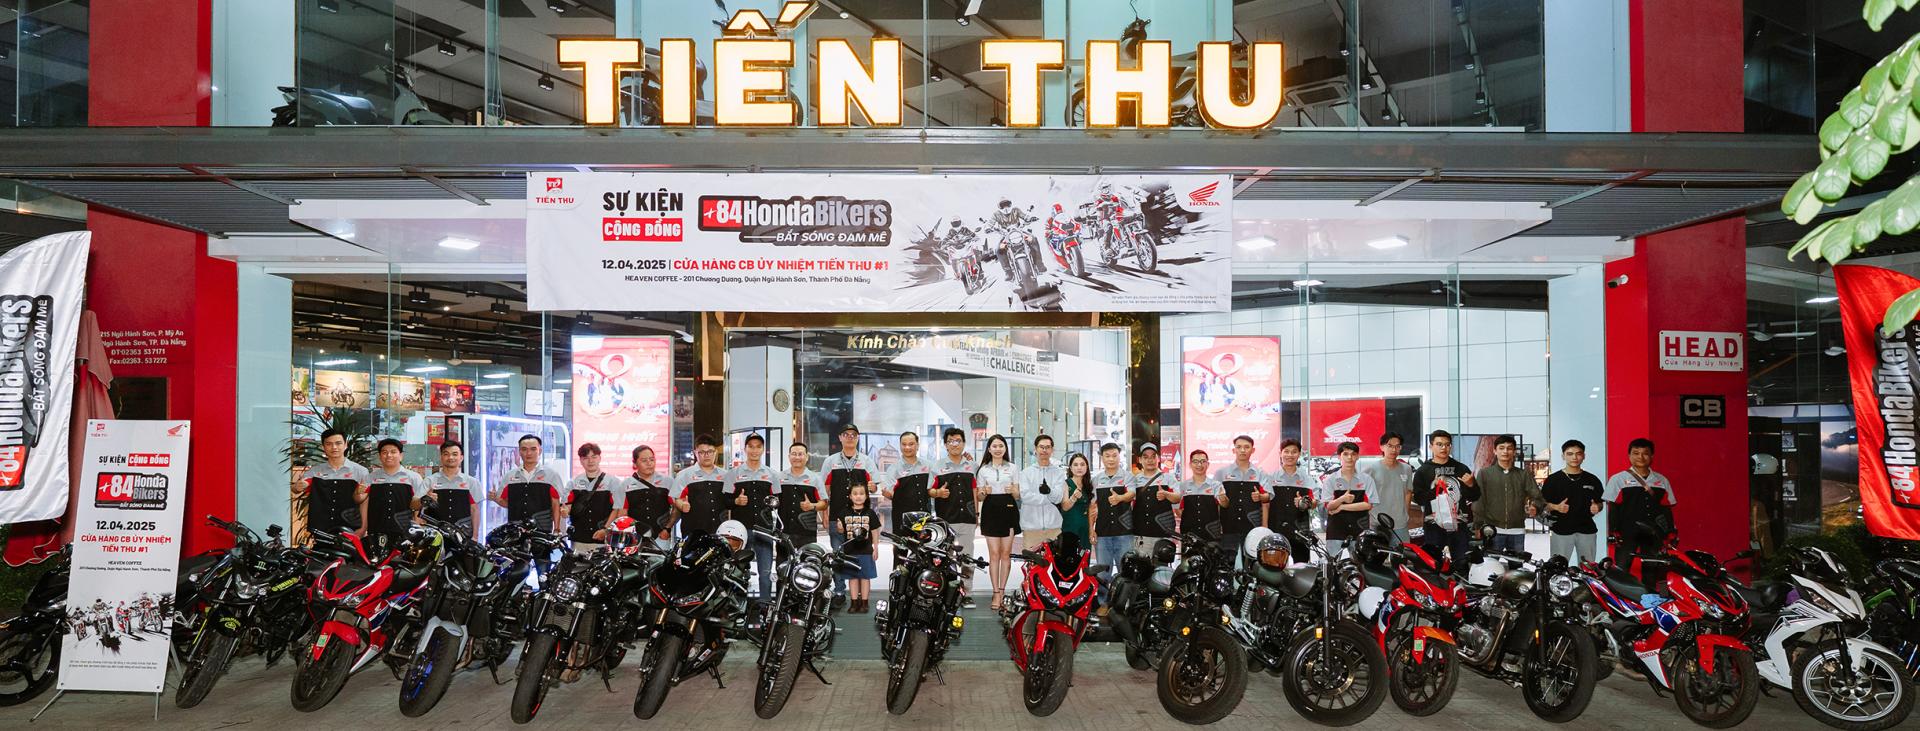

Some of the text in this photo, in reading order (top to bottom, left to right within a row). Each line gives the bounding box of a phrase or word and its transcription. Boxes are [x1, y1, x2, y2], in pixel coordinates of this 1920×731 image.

[557, 0, 1285, 130] TIẾN THU
[603, 188, 684, 217] SỰ KIỆN
[604, 217, 681, 240] CỘNG ĐỒNG
[776, 229, 888, 242] BẮT SÓNG ĐAM MÊ
[601, 259, 667, 270] 12.04.2025
[673, 257, 700, 271] CỬA
[701, 257, 737, 271] HÀNG
[738, 259, 755, 271] CB
[757, 256, 774, 271] ỦY
[776, 258, 815, 273] NHIỆM
[817, 257, 845, 271] TIẾN
[847, 260, 872, 271] THU
[874, 260, 889, 271] #1
[846, 334, 883, 349] Kính
[886, 334, 926, 349] Chào
[1664, 336, 1739, 358] HEAD
[28, 299, 48, 411] BẮT SÓNG ĐAM MÊ
[990, 356, 1036, 375] CHALLENGE
[1684, 399, 1722, 417] CB
[98, 453, 169, 467] SỰ KIỆN CỘNG ĐỒNG
[134, 475, 166, 488] Honda
[132, 487, 166, 501] Bikers
[96, 520, 156, 531] 12.04.2025
[81, 533, 172, 545] CỬA HÀNG CB ỦY NHIỆM
[102, 543, 119, 553] TIẾN
[121, 545, 136, 553] THU
